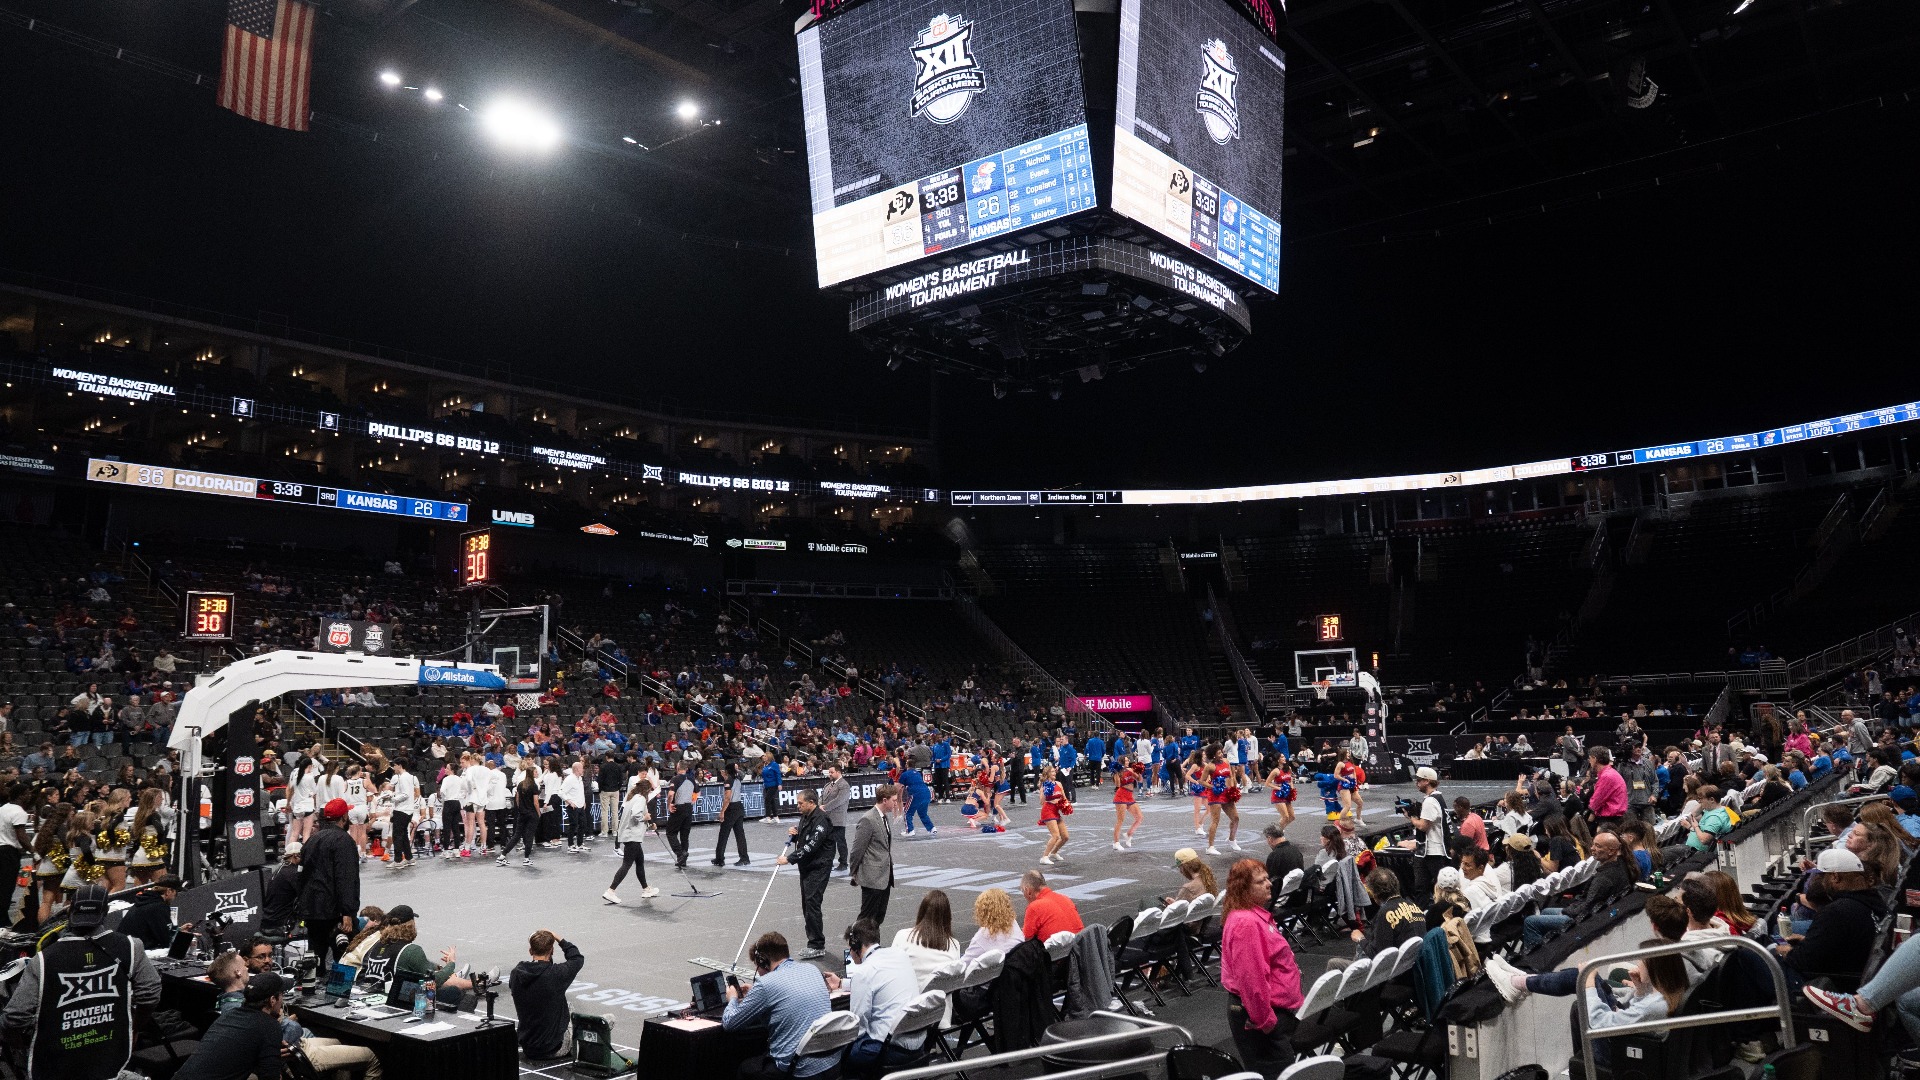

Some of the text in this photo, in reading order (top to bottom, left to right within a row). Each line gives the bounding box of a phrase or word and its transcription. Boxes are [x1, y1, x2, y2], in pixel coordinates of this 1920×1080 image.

[914, 80, 981, 110] TOURNAMENT
[915, 73, 979, 99] BASKETBALL
[1006, 164, 1015, 174] 12
[1064, 145, 1071, 155] 11
[1079, 141, 1084, 150] 2
[1007, 177, 1017, 186] 21
[1066, 159, 1072, 168] 2
[1080, 154, 1086, 163] 0
[1009, 190, 1019, 200] 22
[1081, 169, 1087, 178] 2
[1069, 187, 1075, 195] 2
[925, 184, 958, 209] 3:38
[1071, 201, 1077, 210] 0
[1195, 190, 1216, 216] 3:38
[977, 196, 1000, 219] 26
[924, 225, 931, 233] 4
[960, 225, 965, 233] 4
[971, 218, 1010, 239] KANSAS
[1223, 229, 1237, 251] 26
[886, 271, 940, 301] WOMEN'S
[942, 249, 1031, 283] BASKETBALL
[1150, 251, 1237, 305] WOMEN'S BASKETBALL
[910, 271, 999, 308] TOURNAMENT
[1173, 274, 1226, 311] TOURNAMENT
[52, 367, 176, 396] WOMEN'S BASKETBALL
[77, 381, 154, 402] TOURNAMENT
[1809, 425, 1834, 437] 10/34
[1878, 414, 1896, 424] 5/8
[368, 421, 500, 454] PHILLIPS 66 BIG 12
[533, 446, 607, 465] WOMEN'S BASKETBALL
[1645, 445, 1692, 460] KANSAS
[1706, 440, 1725, 453] 26
[547, 456, 594, 470] TOURNAMENT
[1514, 461, 1569, 476] COLORADO
[679, 472, 790, 492] PHILLIPS 66 BIG 12
[820, 481, 891, 493] WOMEN'S BASKETBALL
[138, 467, 433, 516] 36 COLORADO 3:38 3RD KANSAS 26
[834, 489, 878, 499] TOURNAMENT
[1070, 493, 1087, 501] State
[492, 509, 535, 525] UMB
[469, 534, 489, 552] 3:38
[816, 542, 840, 552] Mobile
[467, 552, 486, 581] 30
[199, 598, 228, 613] 3:38
[197, 614, 221, 632] 30
[1323, 616, 1339, 625] 3:38
[332, 632, 348, 643] 66
[1322, 625, 1338, 639] 30
[440, 671, 476, 683] Allstate
[1096, 698, 1132, 710] Mobile
[238, 763, 251, 772] 66
[350, 785, 360, 795] 13
[237, 795, 251, 804] 66
[238, 828, 251, 837] 66
[213, 888, 249, 912] XII
[56, 963, 120, 1009] XII
[62, 1003, 115, 1021] CONTENT
[61, 1013, 115, 1031] & SOCIAL
[60, 1028, 98, 1044] Unleash
[1815, 1030, 1823, 1040] 2
[64, 1039, 83, 1050] the
[1631, 1048, 1637, 1058] 1
